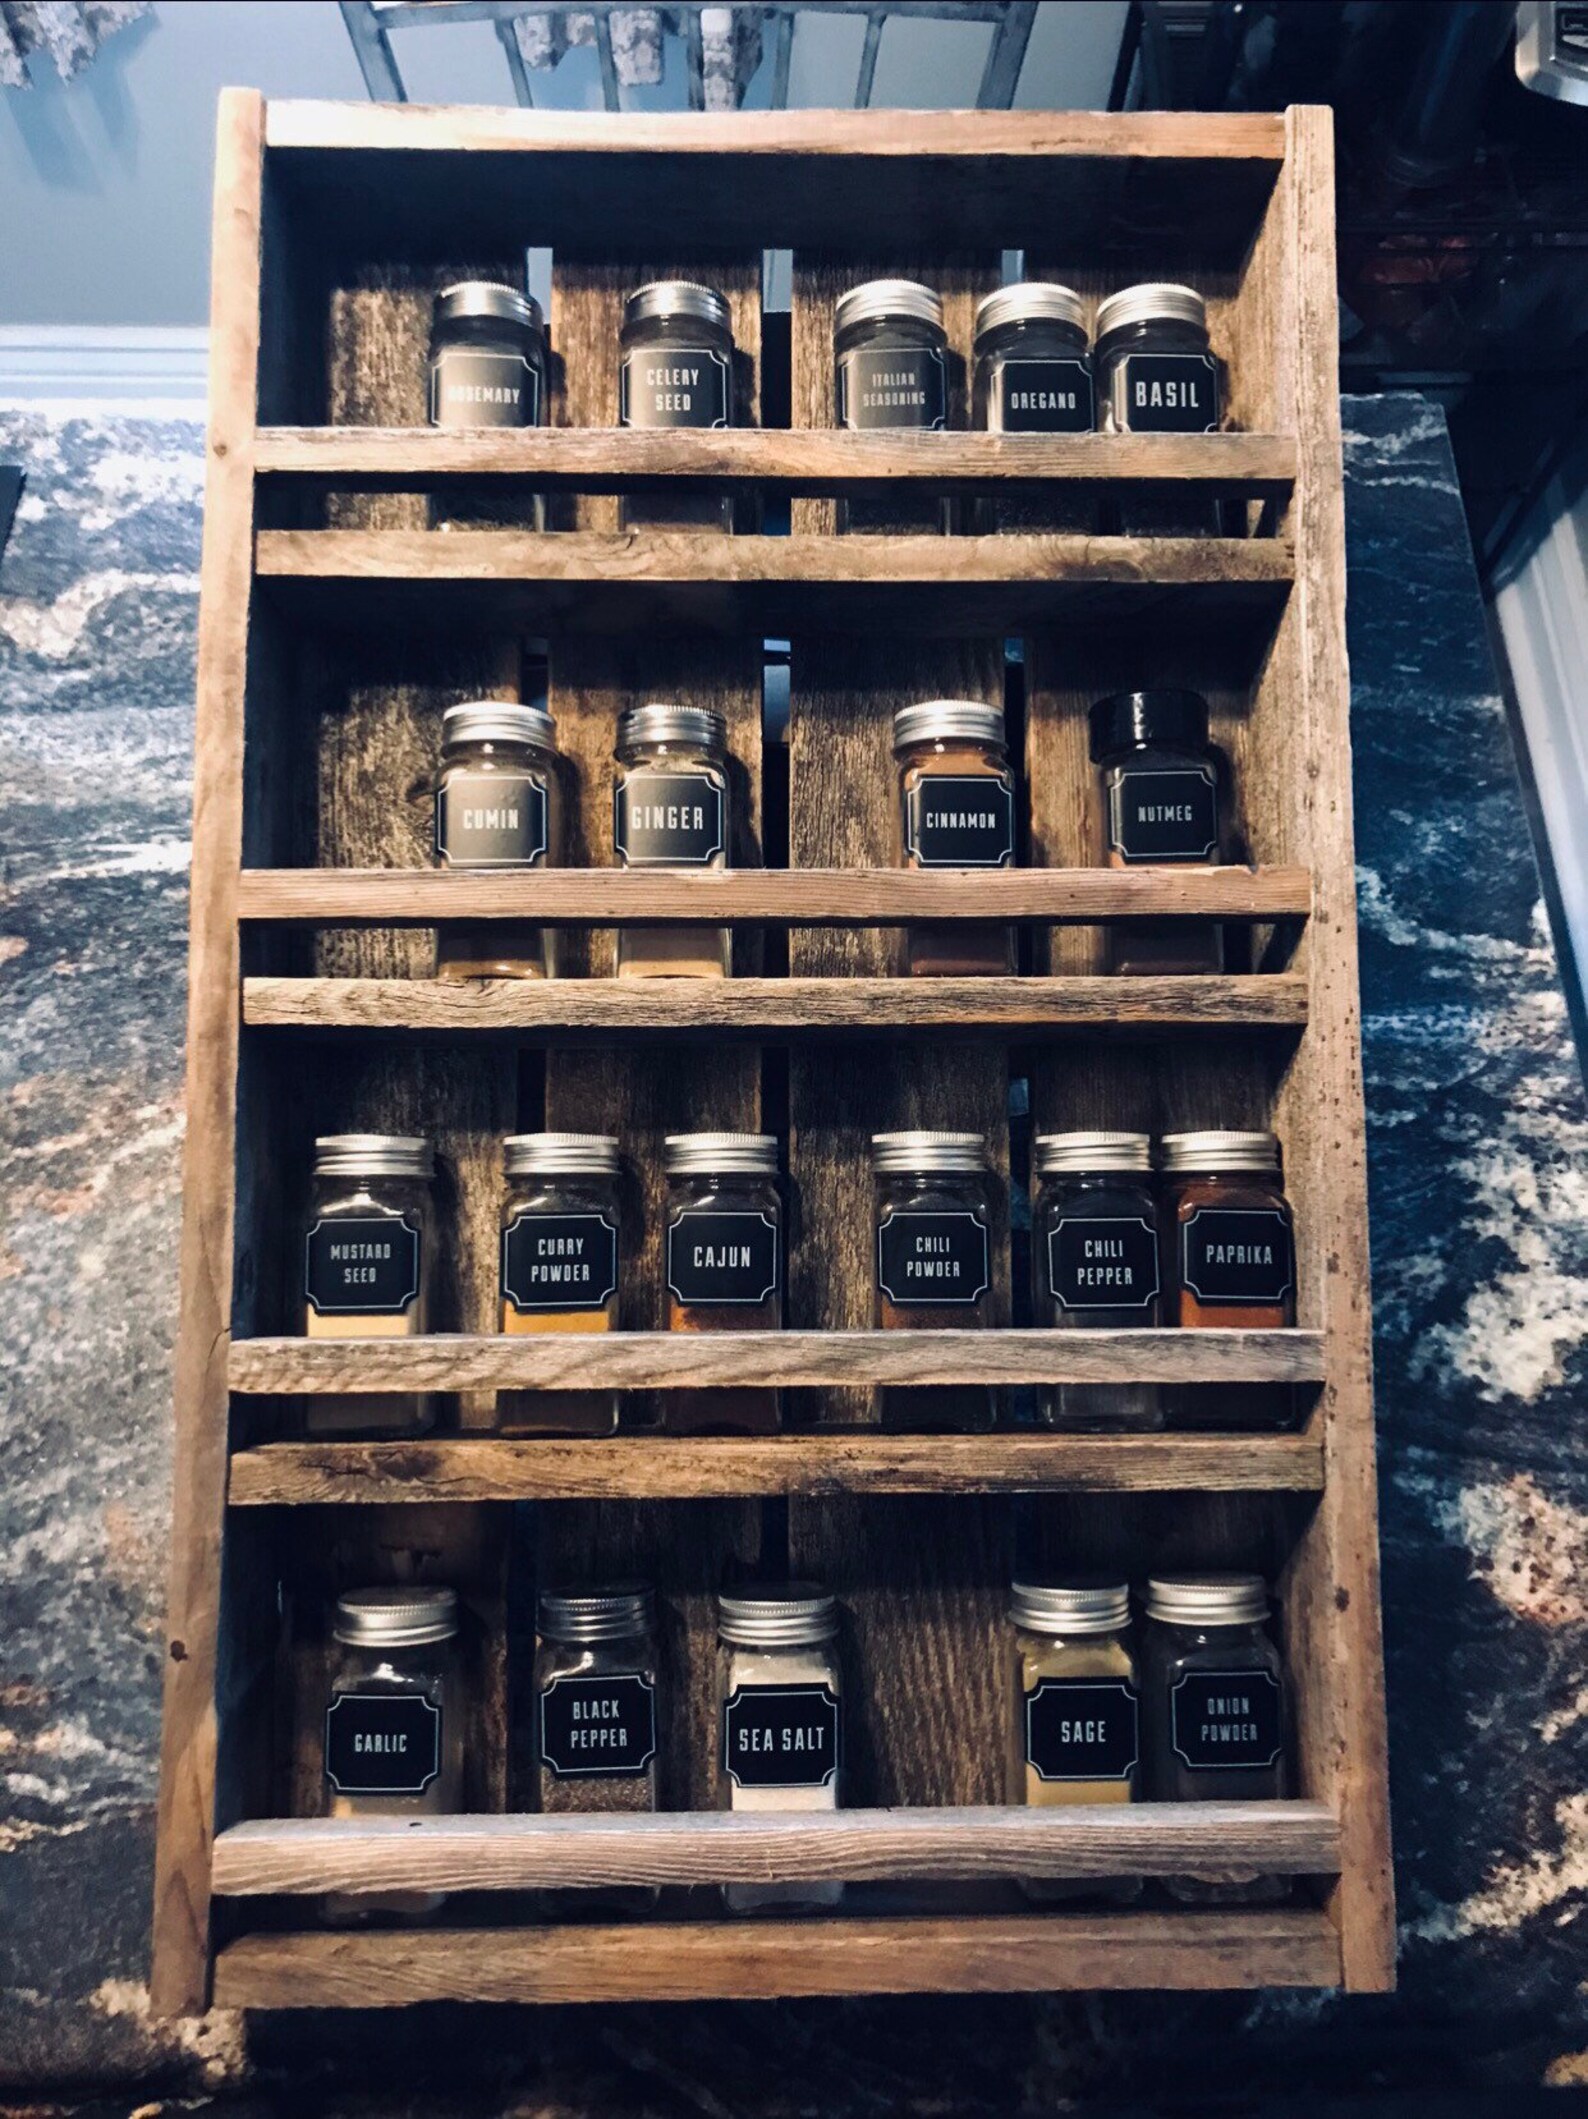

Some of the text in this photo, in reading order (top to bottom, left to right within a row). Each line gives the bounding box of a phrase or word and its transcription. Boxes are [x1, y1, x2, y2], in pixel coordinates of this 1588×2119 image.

[646, 368, 699, 386] CELERY
[872, 372, 915, 387] ITALIAN
[448, 385, 520, 404] SEMARY
[655, 394, 691, 411] SEED
[863, 392, 925, 407] SEASONING
[1011, 392, 1076, 410] OREGANO
[1136, 381, 1199, 408] BASIL
[463, 809, 519, 830] CUMIN
[631, 806, 704, 830] GINGER
[926, 812, 996, 829] CINNAMON
[1138, 805, 1193, 823] NUTMEG
[330, 1244, 392, 1260] MUSTARD
[538, 1238, 584, 1256] CURRY
[916, 1236, 950, 1253] CHILI
[1084, 1240, 1124, 1258] CHILI
[693, 1246, 751, 1267] CAJUN
[1206, 1245, 1273, 1265] PAPRIKA
[344, 1267, 377, 1284] SEED
[531, 1264, 590, 1283] POWDER
[907, 1261, 960, 1277] POWDER
[1077, 1267, 1133, 1286] PEPPER
[572, 1699, 620, 1721] BLACK
[1207, 1697, 1250, 1715] ONION
[570, 1728, 628, 1749] PEPPER
[738, 1726, 825, 1752] SEA SALT
[1061, 1720, 1107, 1744] SAGE
[1201, 1723, 1258, 1742] POWDER
[354, 1733, 408, 1753] GARLIC
